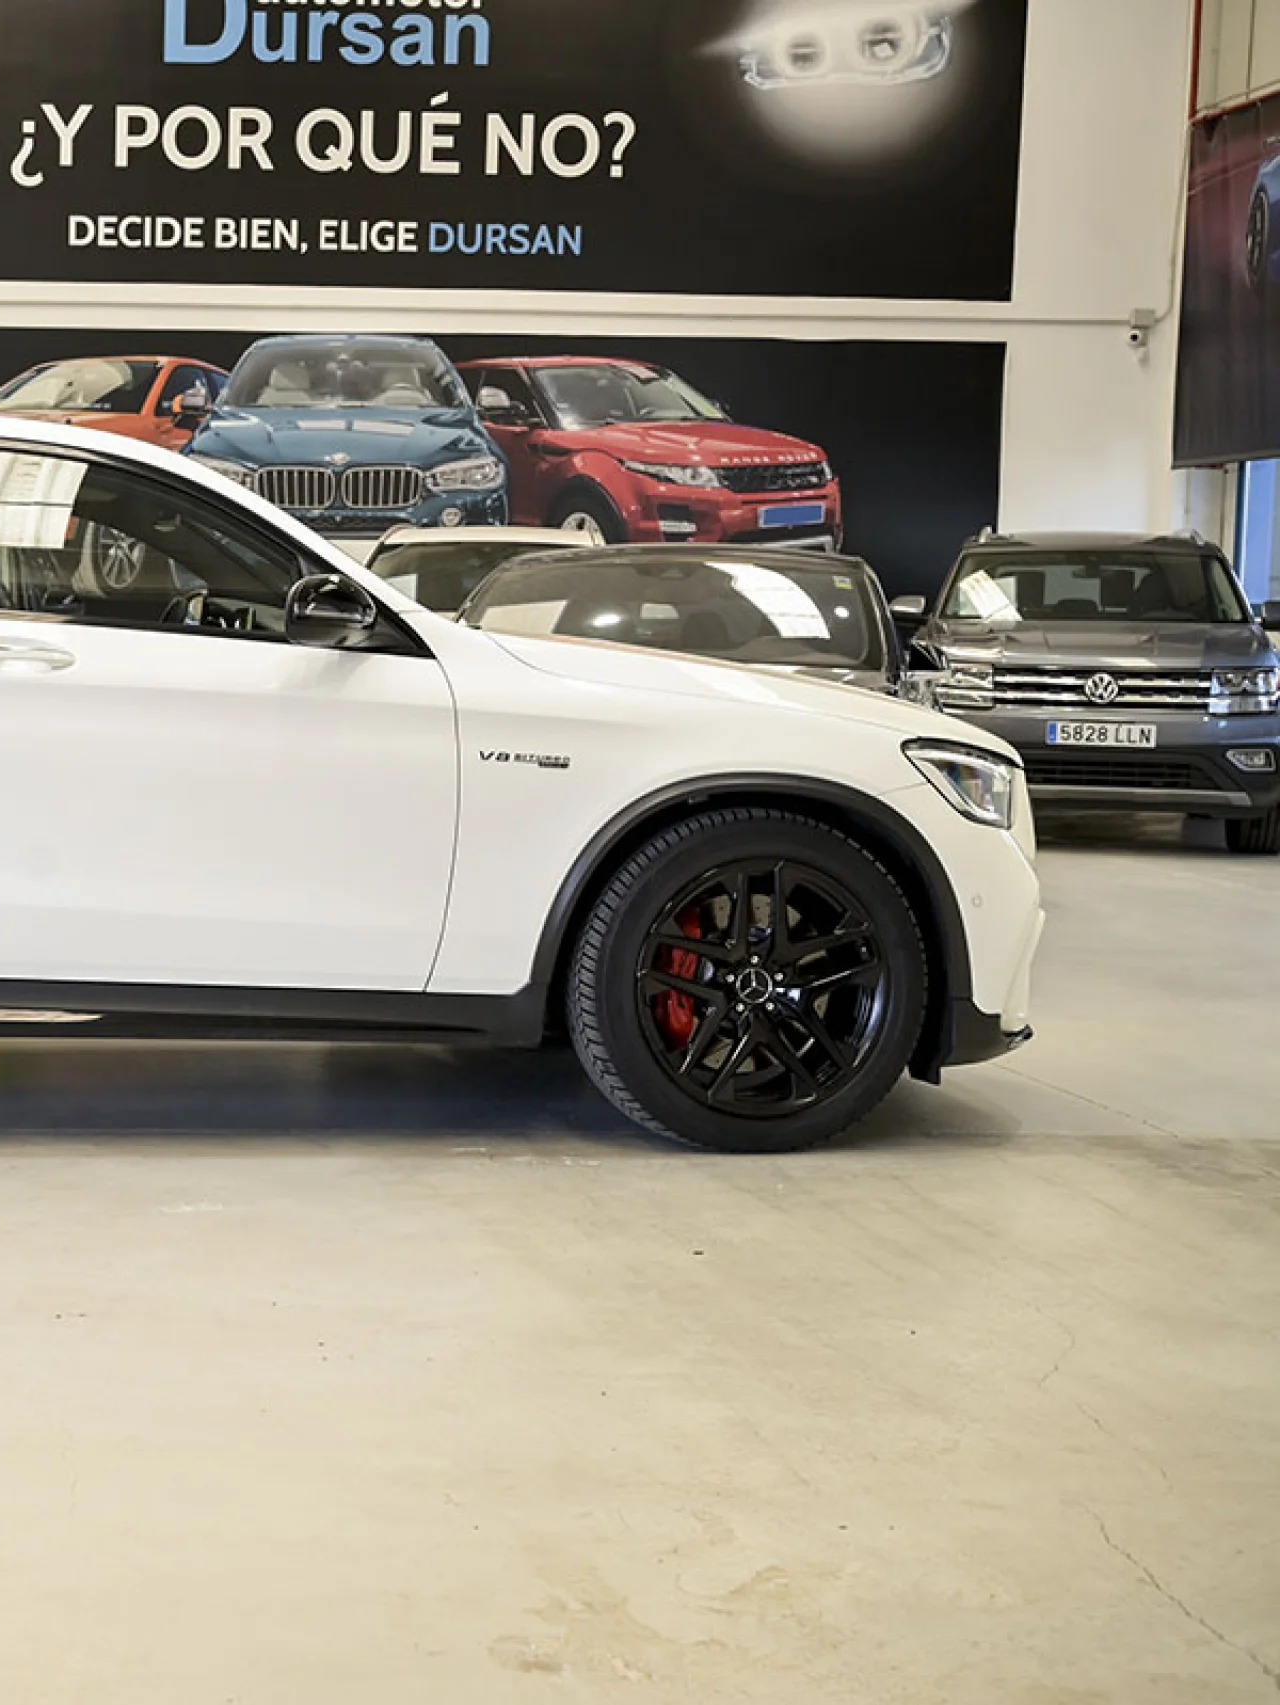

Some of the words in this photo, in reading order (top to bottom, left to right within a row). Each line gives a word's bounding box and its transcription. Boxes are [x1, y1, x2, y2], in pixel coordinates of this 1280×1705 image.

[163, 0, 490, 65] Dursan
[10, 103, 94, 187] ¿Y
[115, 105, 274, 170] POR
[296, 91, 462, 174] QUÉ
[484, 112, 637, 178] NO?
[68, 215, 204, 249] DECIDE
[216, 218, 308, 254] BIEN,
[320, 221, 418, 253] ELIGE
[429, 223, 582, 256] DURSAN
[1061, 725, 1108, 742] 5828
[1115, 727, 1152, 744] LLN
